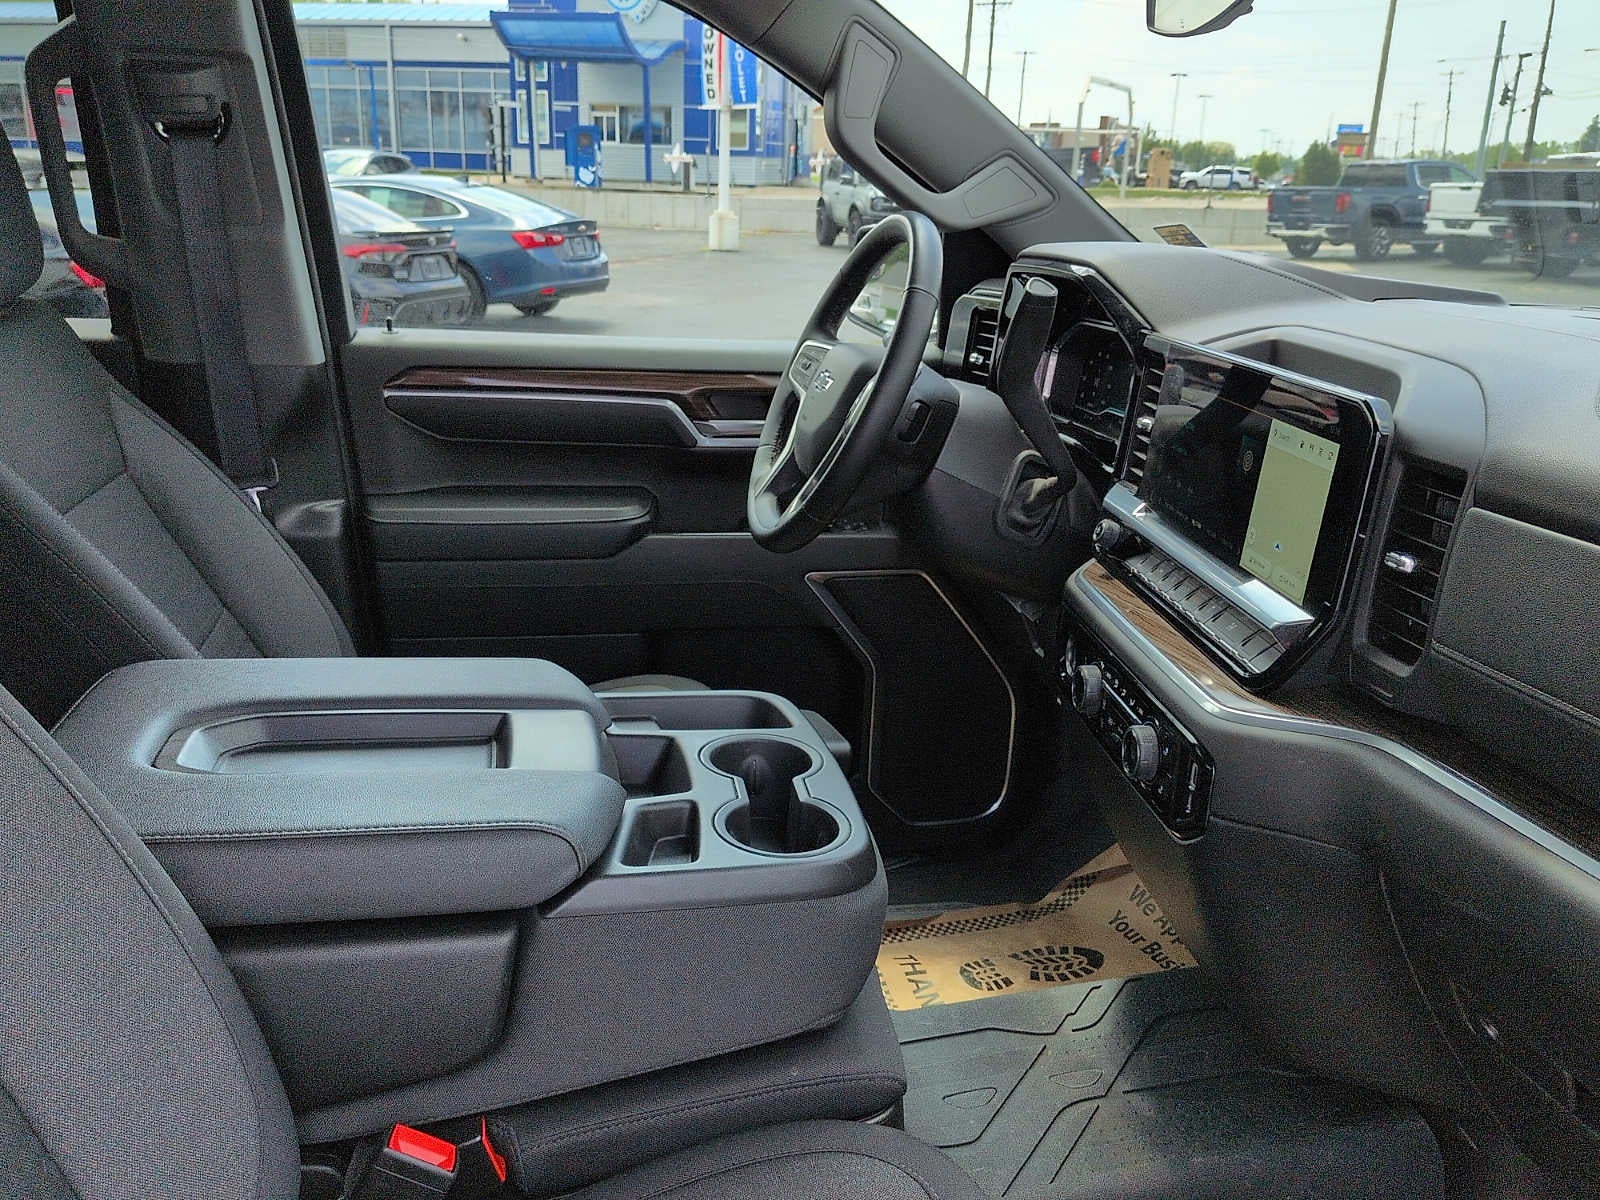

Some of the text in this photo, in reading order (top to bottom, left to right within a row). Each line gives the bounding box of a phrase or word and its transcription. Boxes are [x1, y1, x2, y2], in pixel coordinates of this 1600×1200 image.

[704, 27, 716, 100] OWNED
[734, 42, 748, 103] OLET
[1128, 883, 1158, 917] We
[1109, 909, 1147, 945] Your
